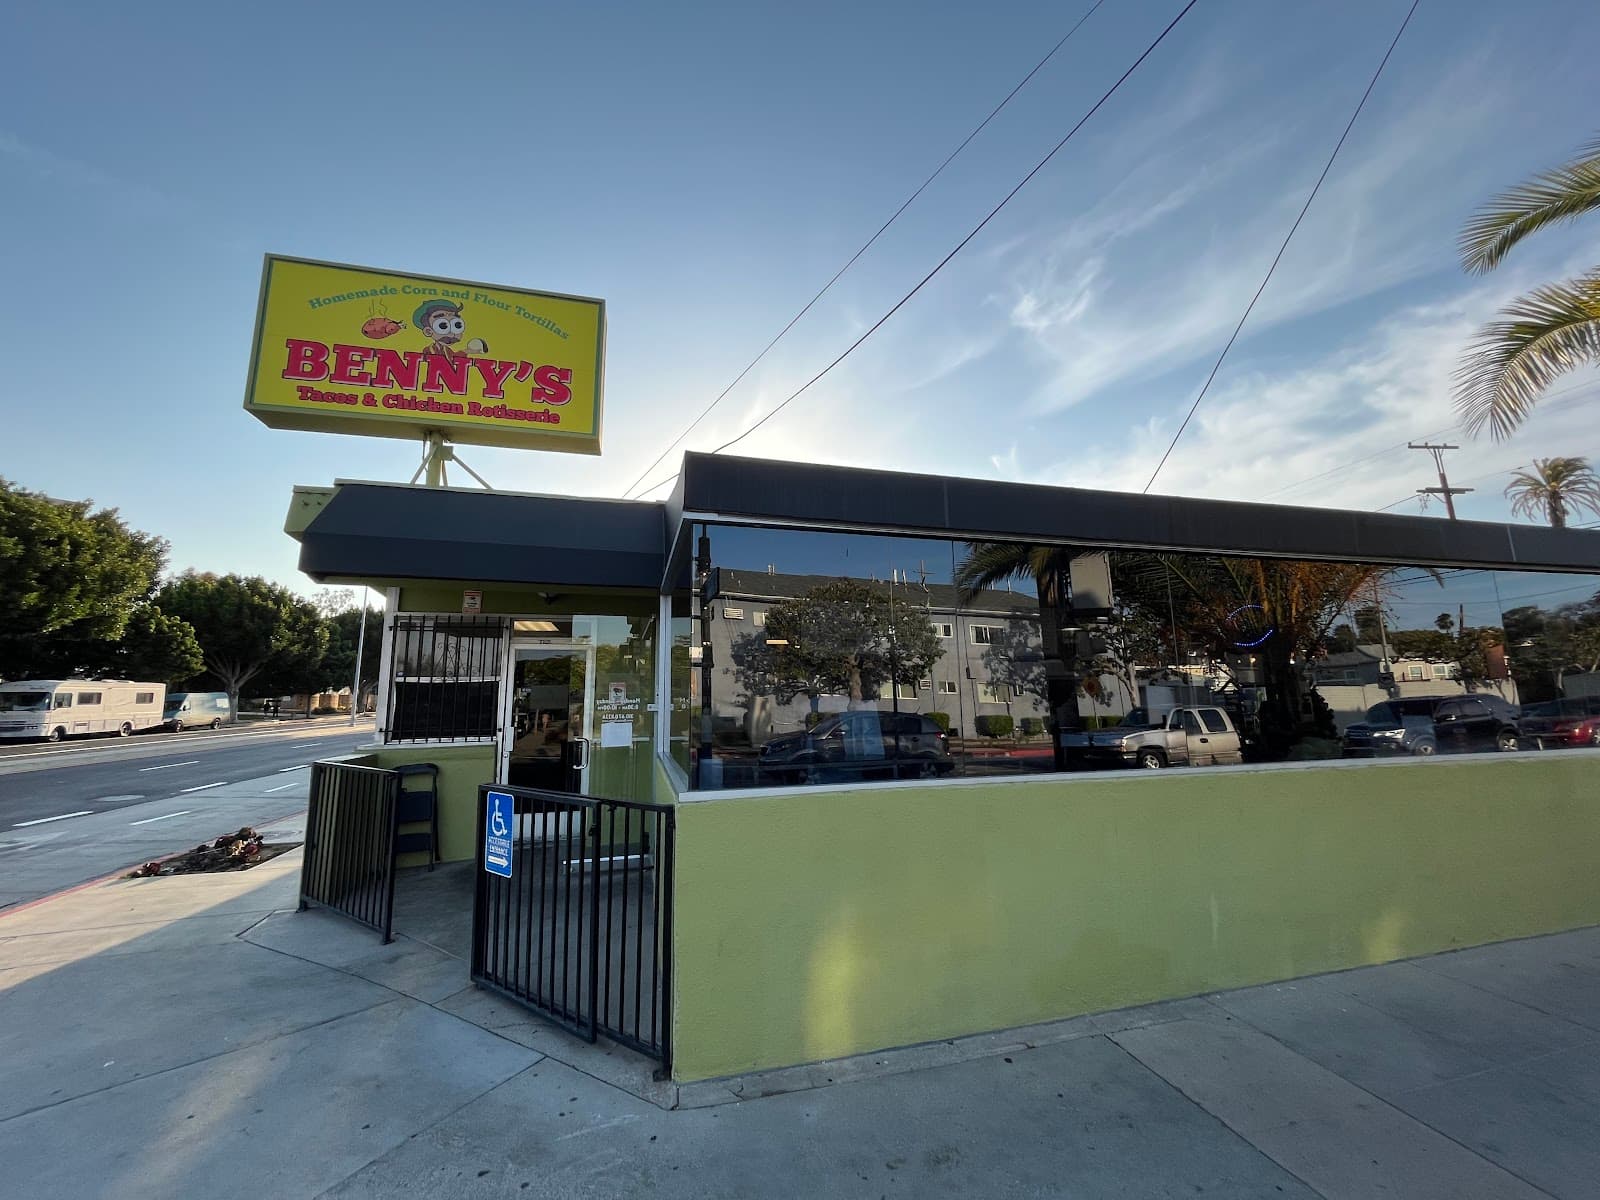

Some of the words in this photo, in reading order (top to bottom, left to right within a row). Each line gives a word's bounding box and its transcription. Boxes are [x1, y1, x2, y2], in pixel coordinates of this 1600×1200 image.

[309, 285, 397, 309] Homemade
[402, 285, 438, 295] Corn
[442, 290, 470, 300] and
[474, 293, 512, 311] Flour
[515, 305, 569, 339] Tortillas
[281, 338, 573, 406] BENNY'S
[296, 385, 358, 405] Tacos
[362, 392, 378, 407] &
[382, 393, 464, 415] Chicken
[467, 401, 561, 424] Rotisserie
